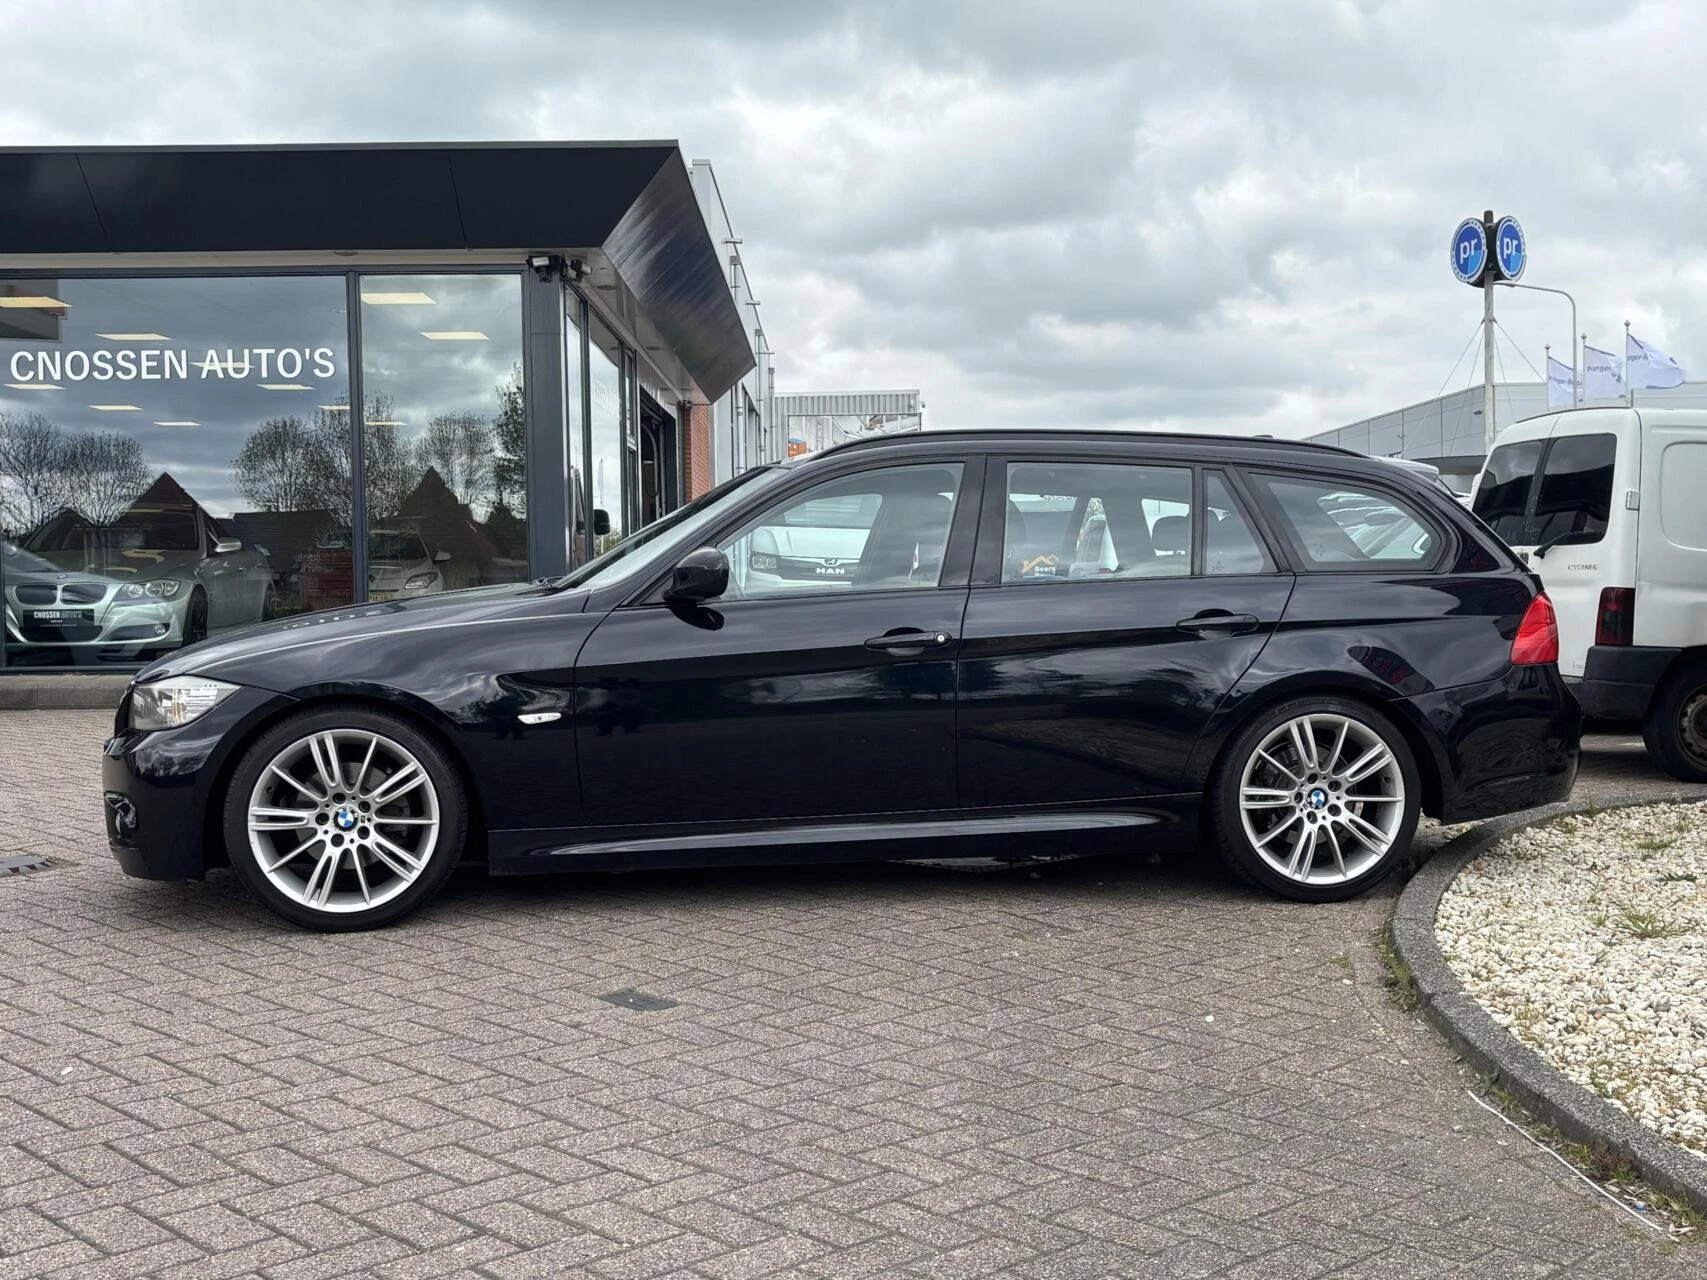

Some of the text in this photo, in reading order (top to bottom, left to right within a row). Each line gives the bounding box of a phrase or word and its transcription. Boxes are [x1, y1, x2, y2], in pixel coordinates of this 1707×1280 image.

[1460, 238, 1478, 264] pr
[1503, 237, 1518, 259] pr
[10, 347, 336, 381] CNOSSEN AUTO'S
[816, 567, 845, 575] MAN
